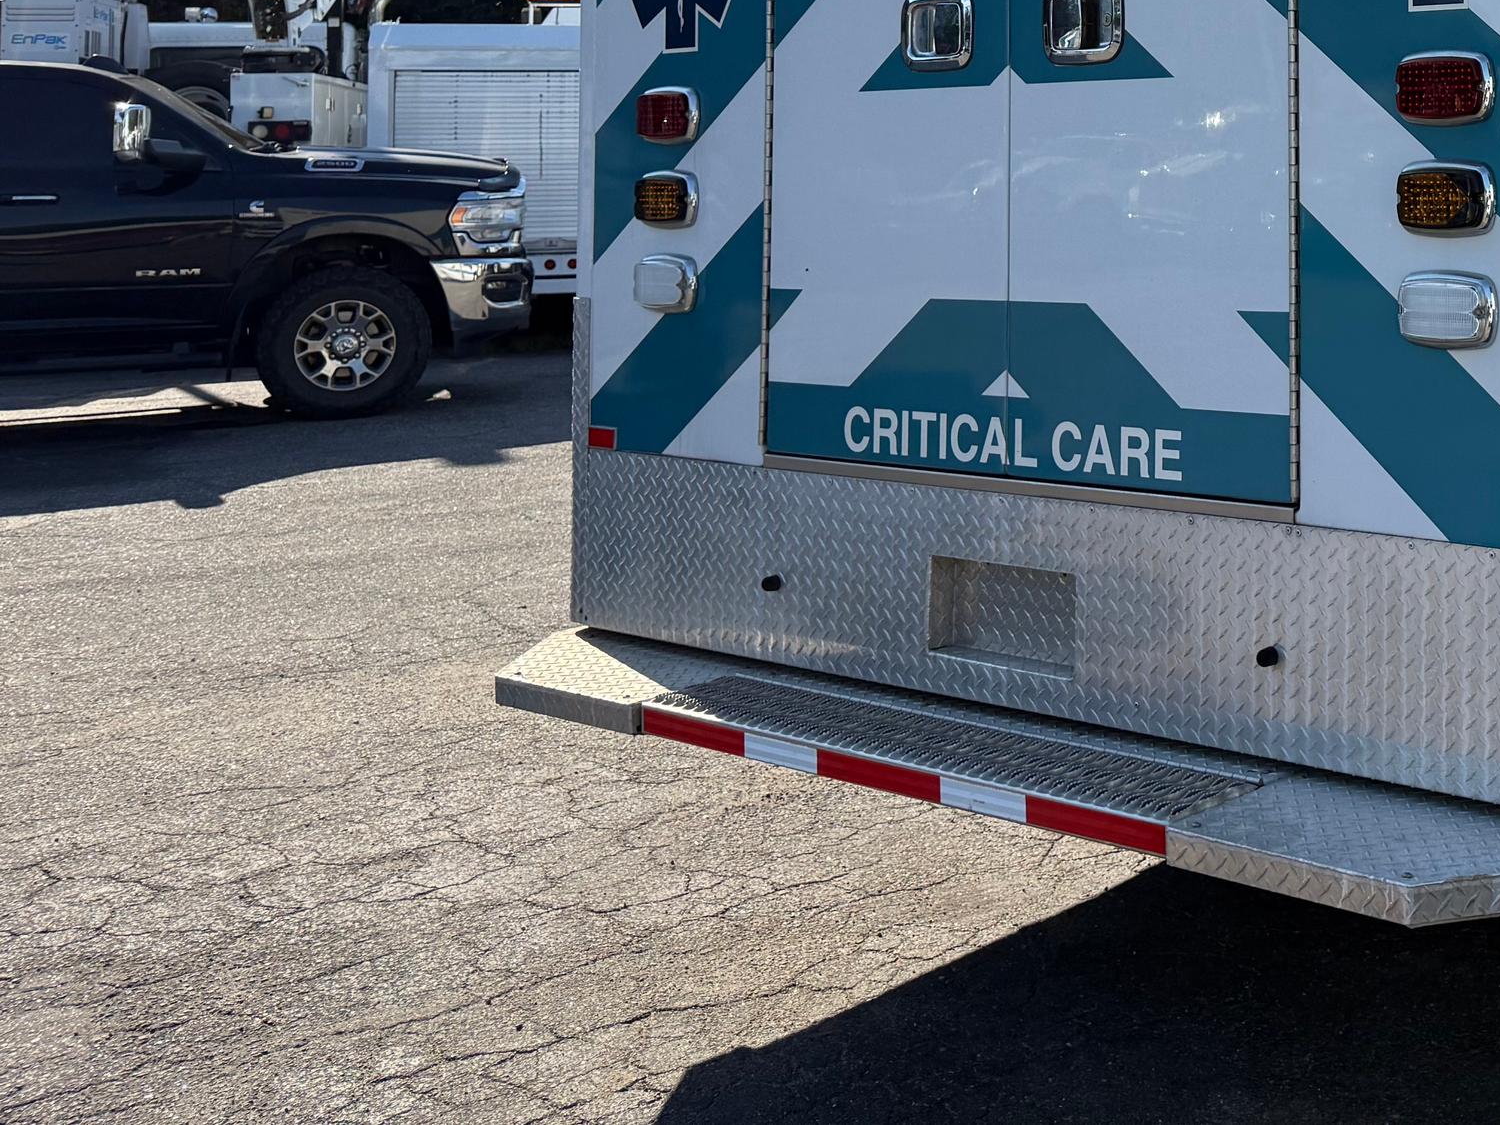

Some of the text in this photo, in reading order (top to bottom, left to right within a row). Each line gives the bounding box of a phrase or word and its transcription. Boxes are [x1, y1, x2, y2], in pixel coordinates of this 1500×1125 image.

[11, 34, 67, 44] EnPak
[135, 267, 201, 277] RAM
[844, 406, 1184, 482] CRITICAL CARE
